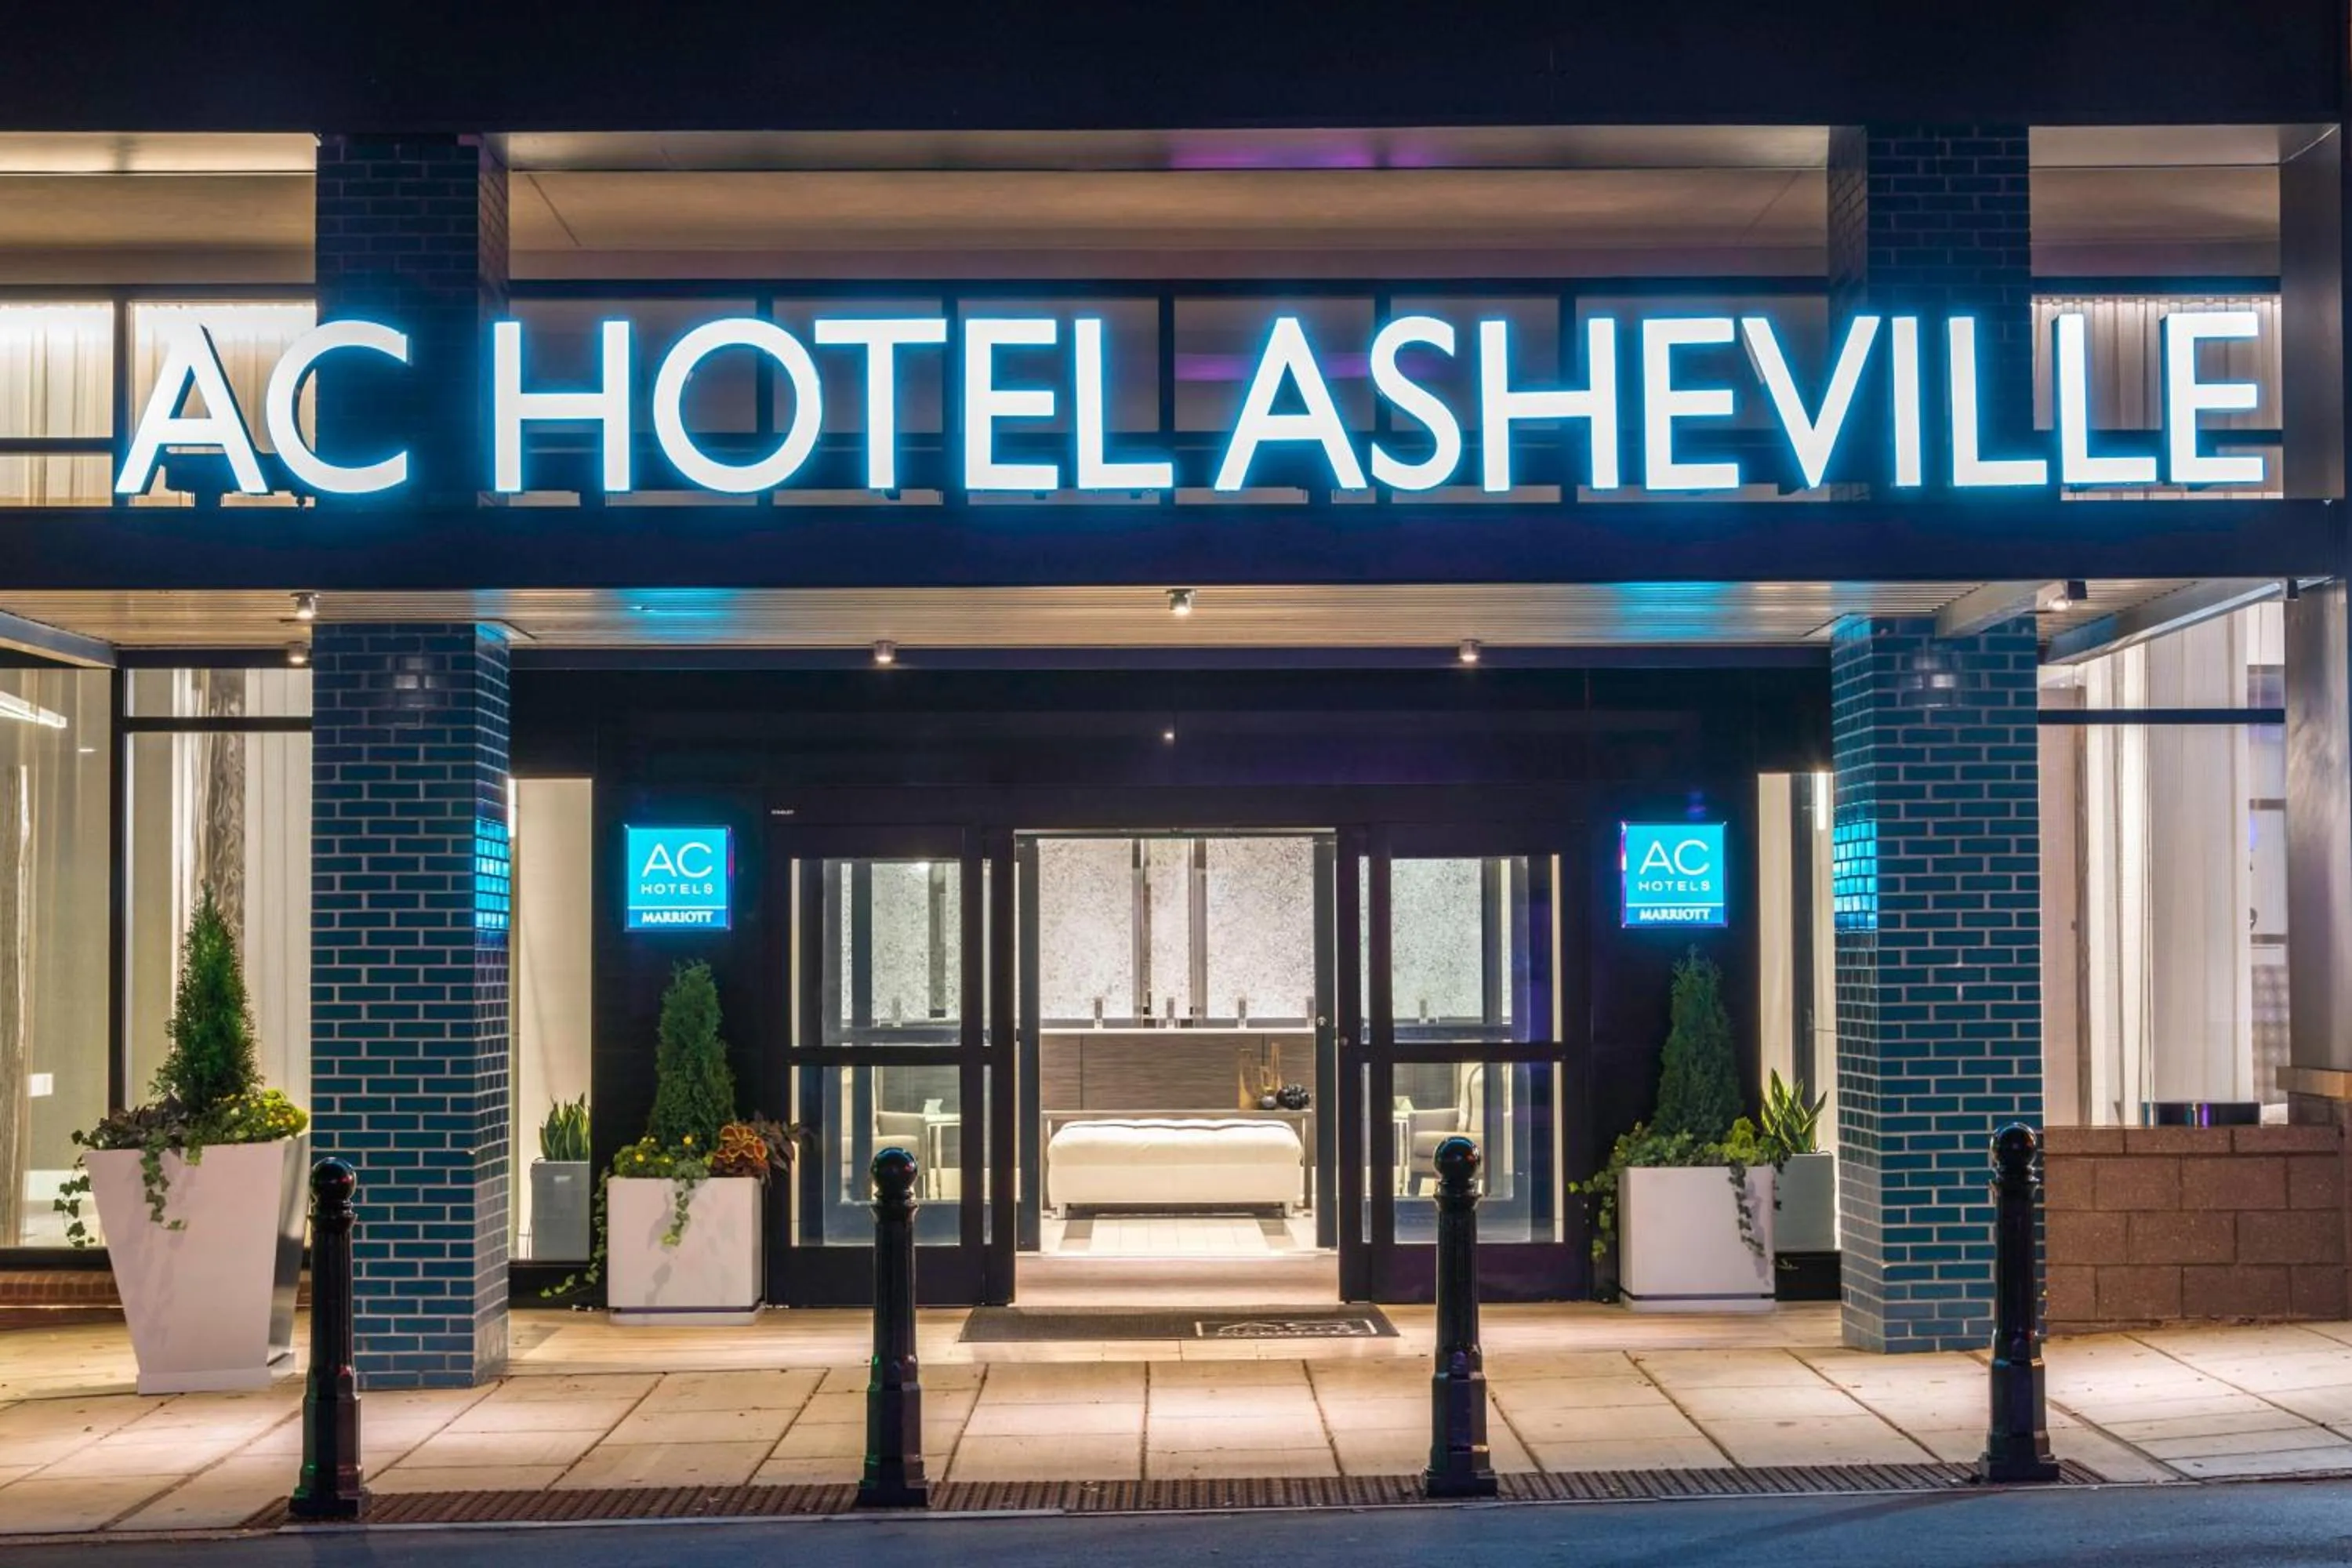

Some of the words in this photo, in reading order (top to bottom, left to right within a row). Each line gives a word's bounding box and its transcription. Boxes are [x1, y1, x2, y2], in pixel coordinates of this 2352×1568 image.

[115, 319, 408, 493] AC
[493, 318, 1174, 493] HOTEL
[1214, 312, 2264, 492] ASHEVILLE
[641, 842, 713, 878] AC
[1639, 839, 1710, 876] AC
[641, 883, 713, 895] HOTELS
[1638, 880, 1711, 891] HOTELS
[641, 910, 714, 924] MARRIOTT
[1639, 907, 1711, 920] MARRIOTT
